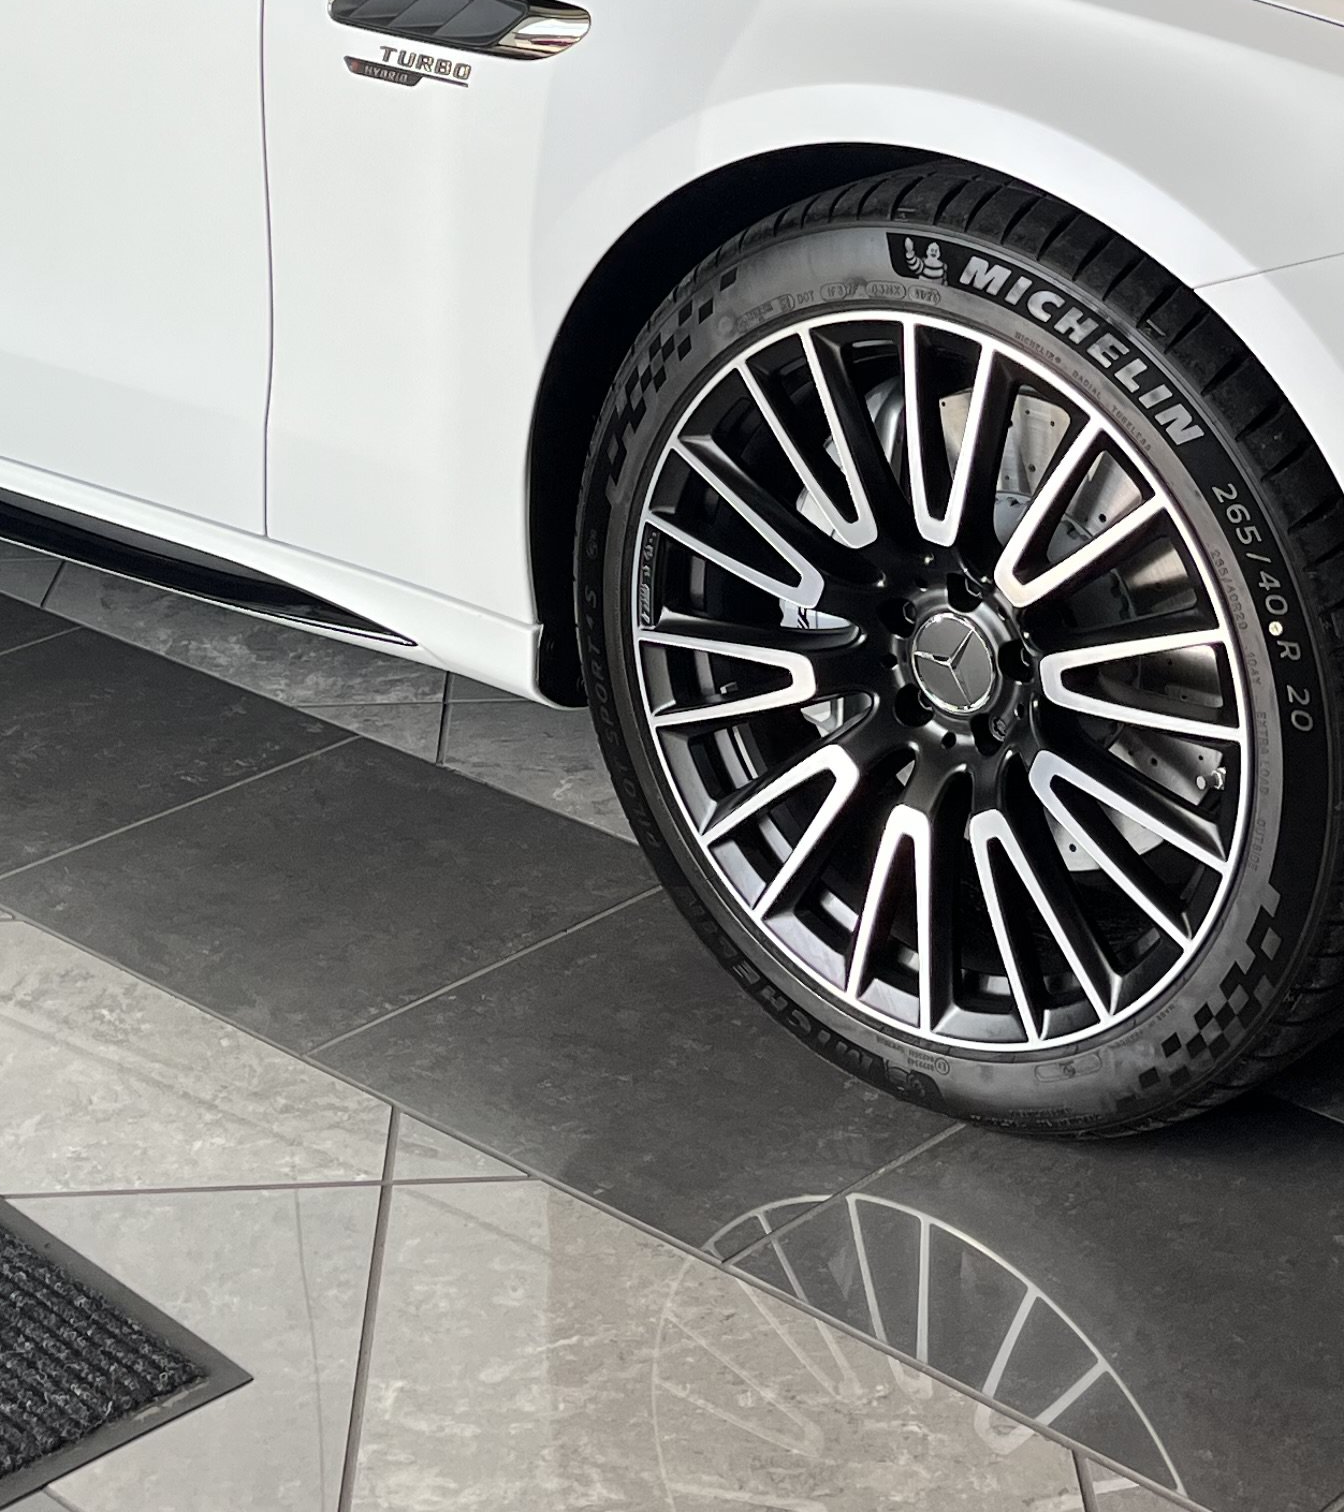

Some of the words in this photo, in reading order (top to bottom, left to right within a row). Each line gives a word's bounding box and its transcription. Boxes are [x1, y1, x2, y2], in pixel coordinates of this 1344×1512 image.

[365, 66, 408, 82] HYBRID
[381, 46, 471, 80] TURBO
[960, 257, 1206, 447] MICHELIN
[1276, 640, 1302, 660] R
[589, 639, 619, 746] SPORT
[1286, 684, 1314, 732] 20
